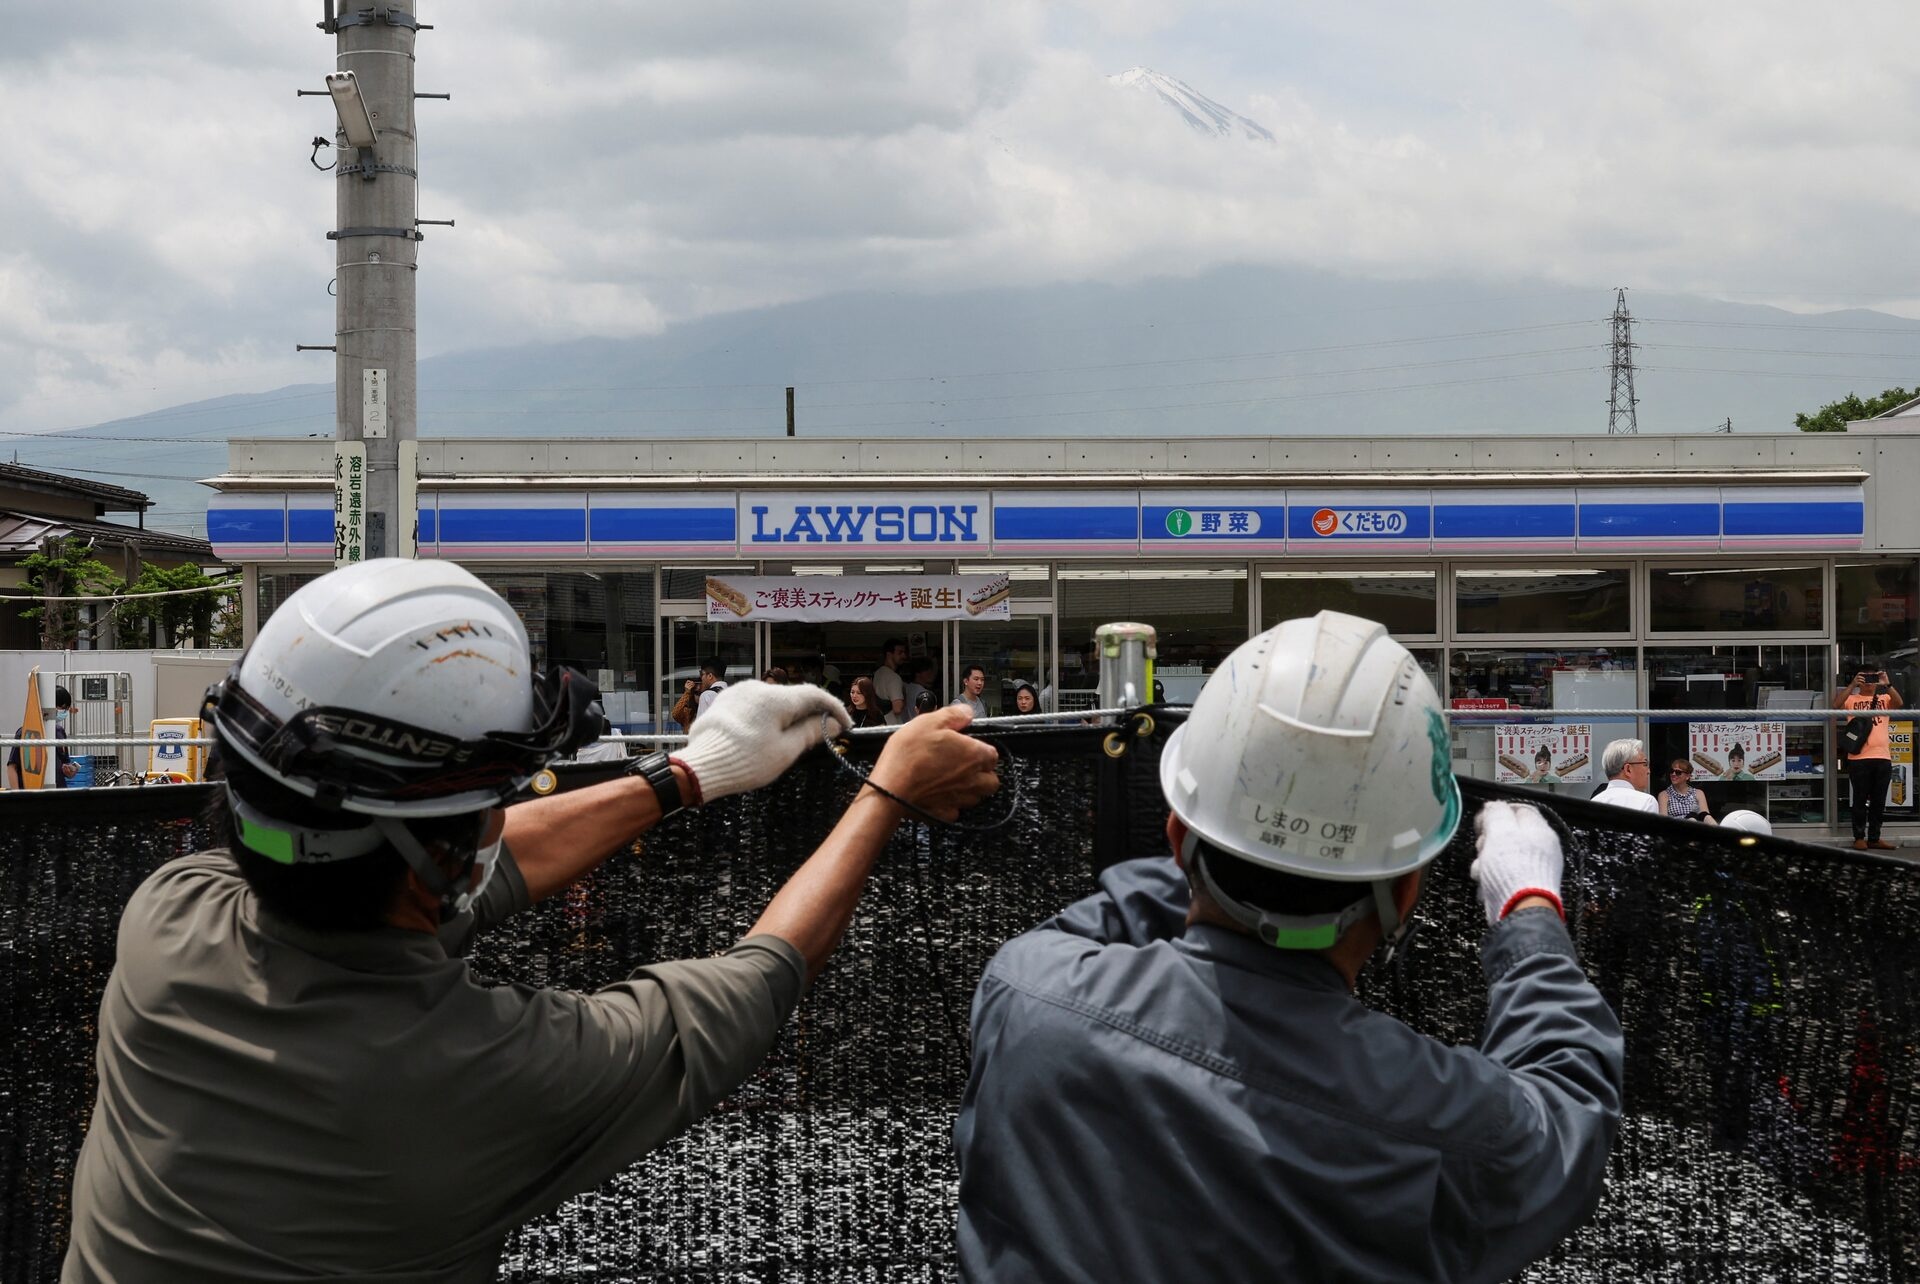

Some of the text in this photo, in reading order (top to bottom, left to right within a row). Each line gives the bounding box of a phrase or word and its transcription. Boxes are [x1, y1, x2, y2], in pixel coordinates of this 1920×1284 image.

[349, 456, 362, 562] 溶岩遠赤外線
[752, 506, 978, 542] LAWSON
[1201, 512, 1249, 532] 野菜
[1342, 512, 1402, 532] くだもの
[1255, 804, 1310, 835] しまの
